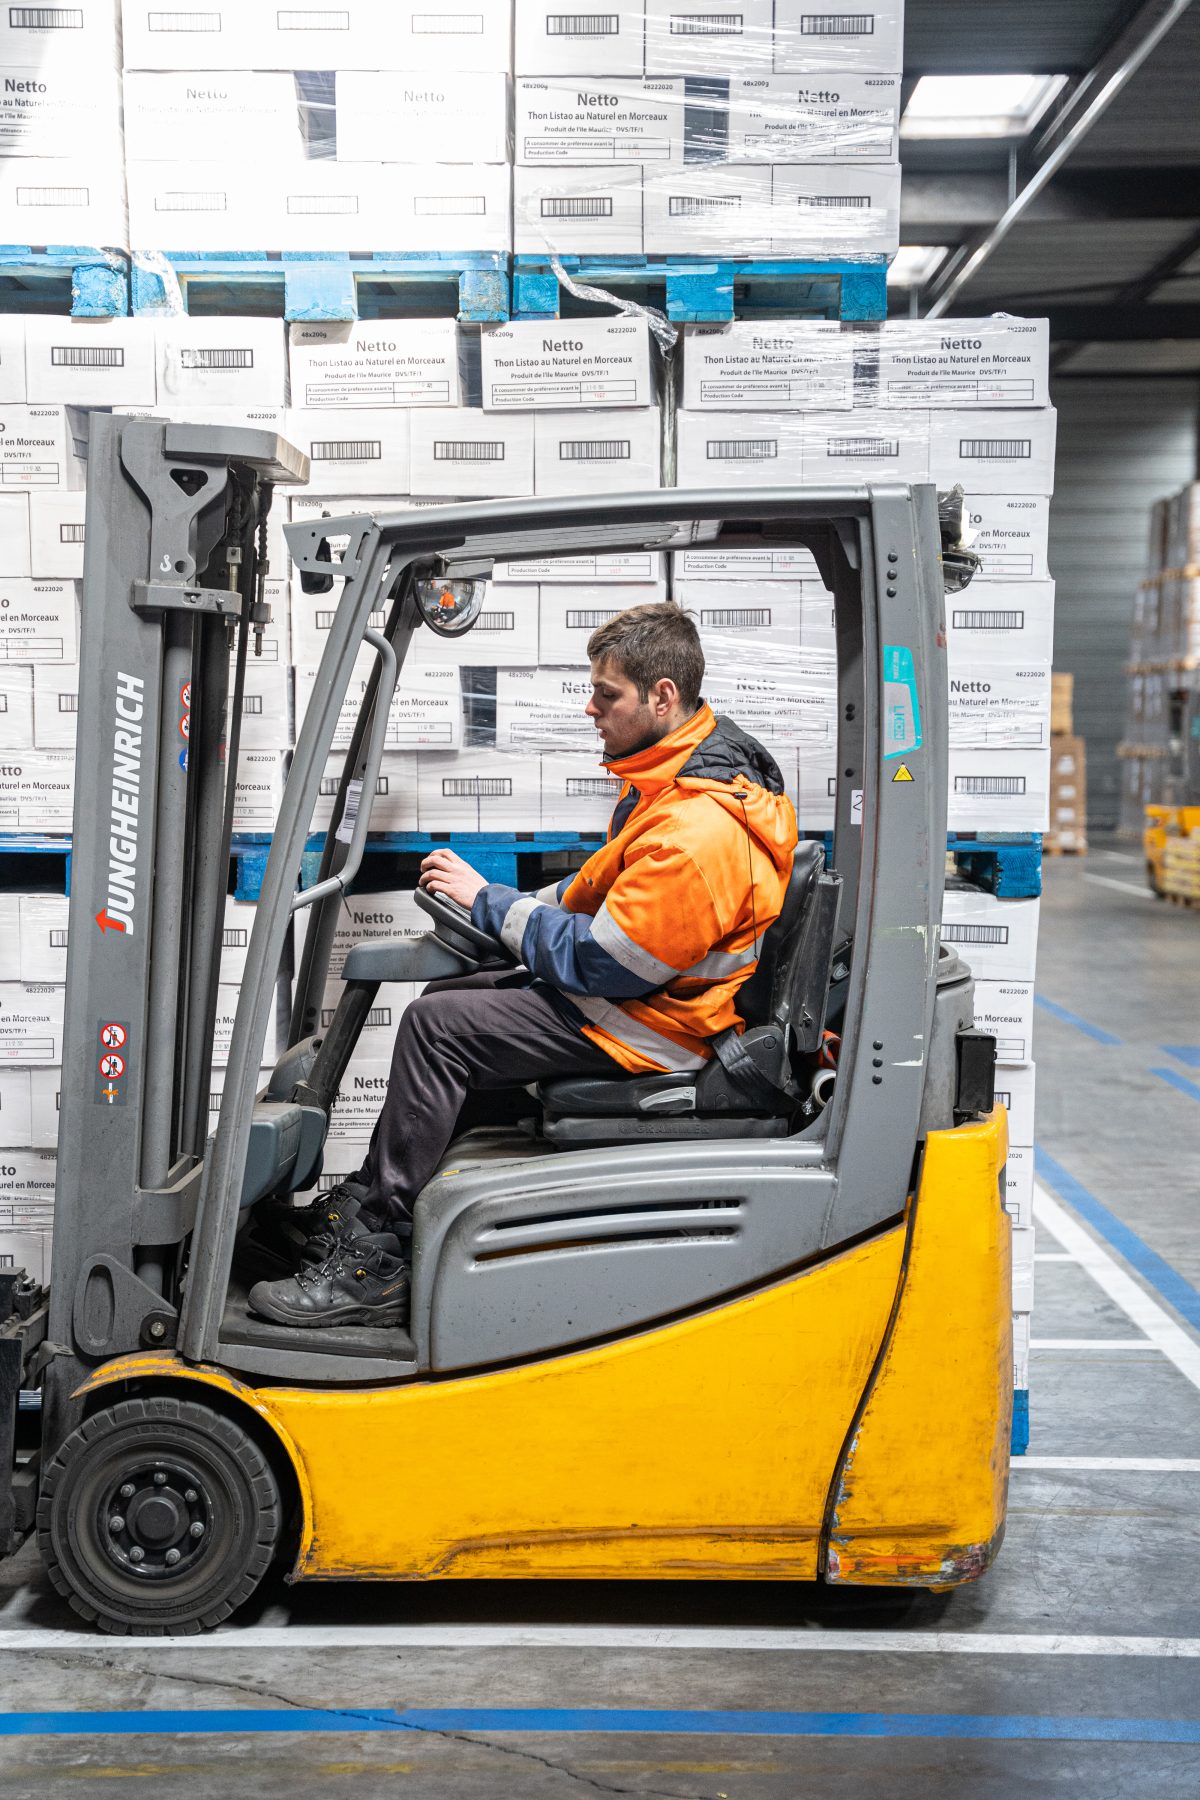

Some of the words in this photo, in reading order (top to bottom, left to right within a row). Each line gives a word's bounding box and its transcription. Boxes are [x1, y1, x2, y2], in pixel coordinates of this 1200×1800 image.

[5, 79, 46, 92] Netto
[404, 90, 444, 103] Netto
[578, 93, 618, 106] Netto
[798, 91, 839, 102] Netto
[550, 112, 573, 120] Listao
[587, 112, 615, 120] Naturel
[629, 112, 667, 120] Morceaux
[357, 341, 396, 352] Netto
[543, 340, 583, 351] Netto
[753, 337, 794, 349] Netto
[941, 338, 982, 349] Netto
[494, 359, 514, 367] Thon
[553, 357, 581, 365] Naturel
[17, 438, 54, 446] Morceaux
[562, 682, 593, 693] Nett
[951, 681, 991, 692] Netto
[105, 671, 144, 936] JUNGHEINRICH
[354, 912, 393, 924] Netto
[363, 929, 391, 937] Naturel
[985, 1015, 1022, 1023] Morceaux
